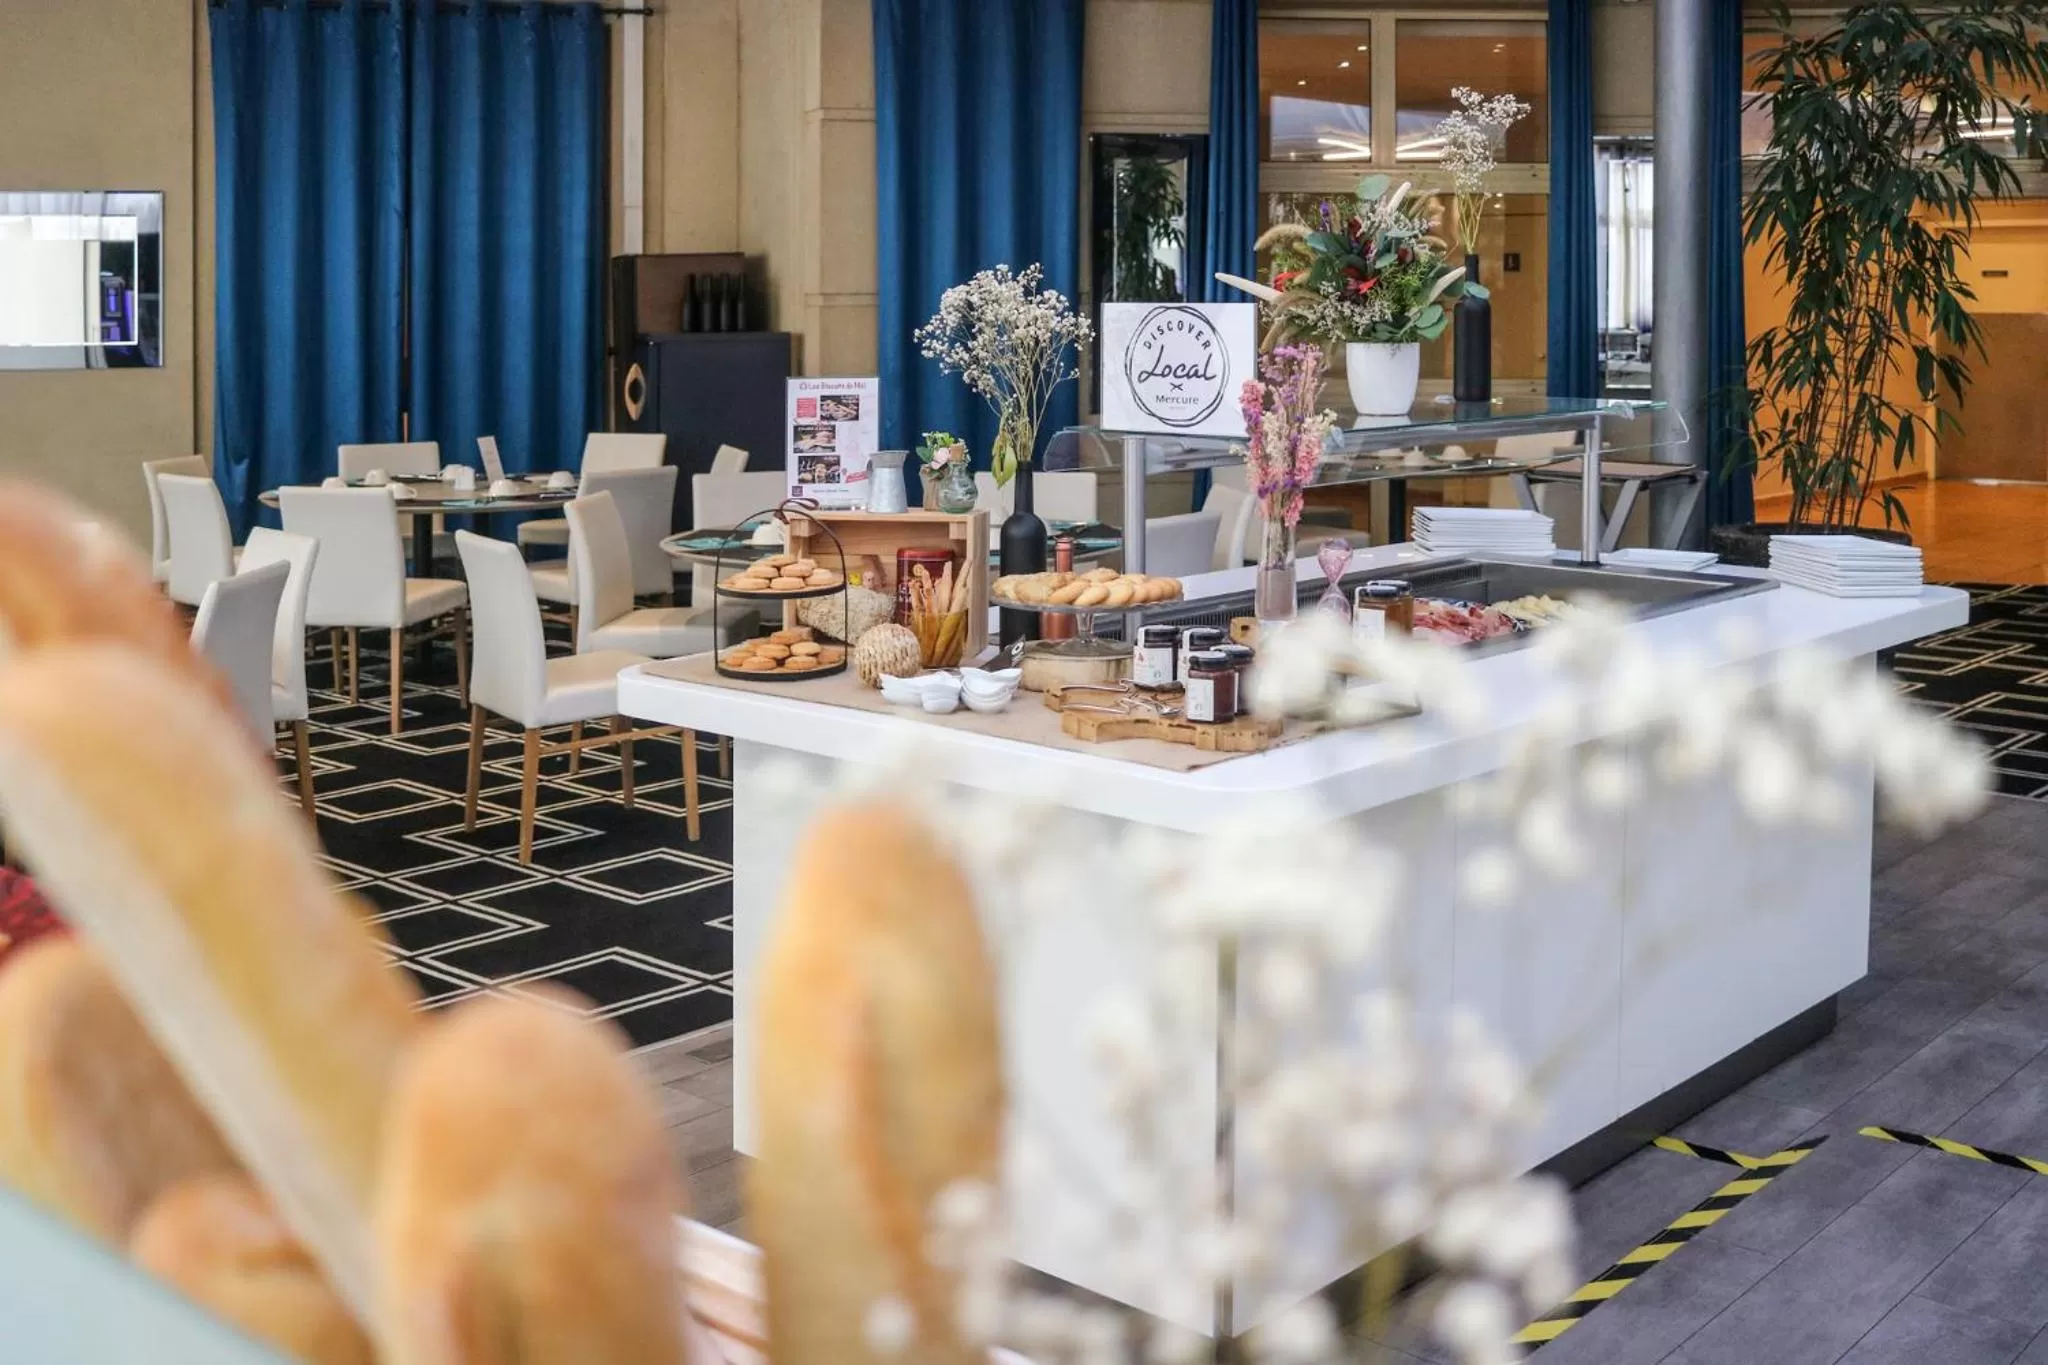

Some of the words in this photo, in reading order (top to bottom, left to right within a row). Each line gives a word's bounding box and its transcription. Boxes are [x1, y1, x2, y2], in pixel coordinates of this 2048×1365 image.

[1143, 320, 1212, 350] DISCOVER
[1137, 344, 1217, 384] Local
[1155, 394, 1200, 405] Mercure
